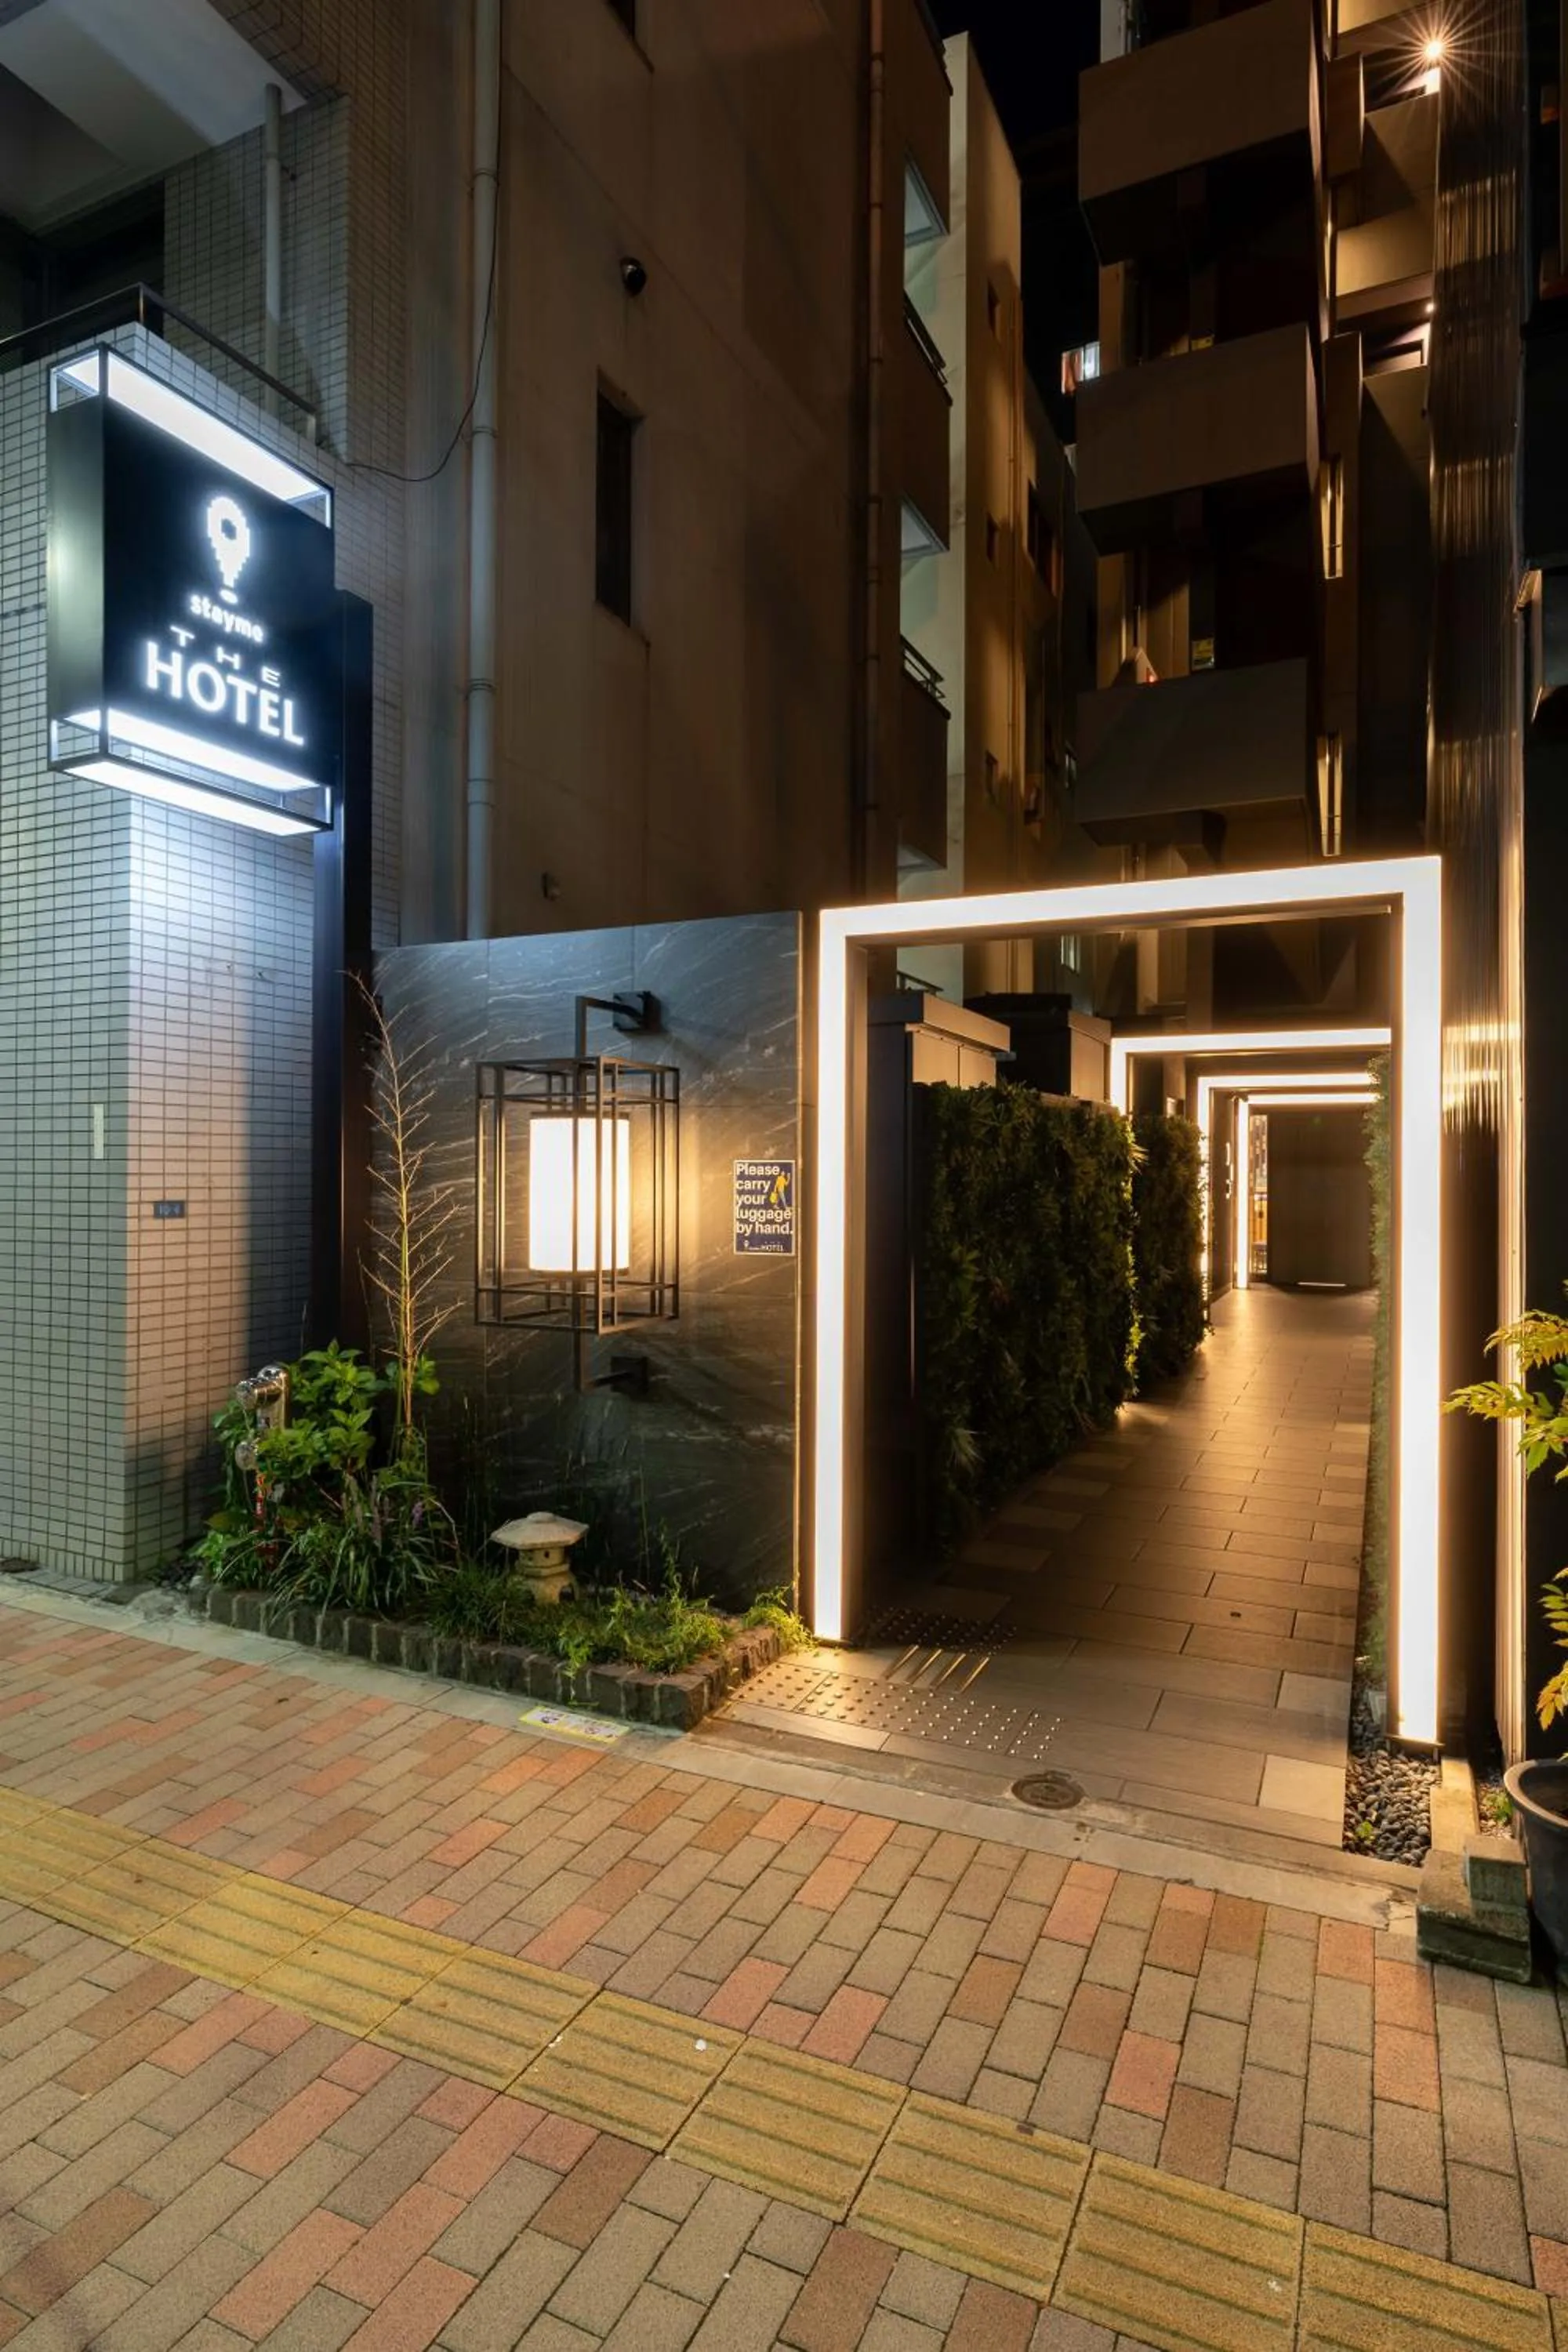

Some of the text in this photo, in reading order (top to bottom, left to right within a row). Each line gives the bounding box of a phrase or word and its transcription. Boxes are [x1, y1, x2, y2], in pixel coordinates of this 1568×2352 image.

[191, 594, 263, 643] stayme
[170, 626, 281, 688] THE
[147, 641, 304, 746] HOTEL
[736, 1163, 780, 1175] Please
[736, 1180, 771, 1192] carry
[736, 1194, 765, 1208] your
[736, 1209, 792, 1222] luggage
[736, 1222, 793, 1236] by hand.
